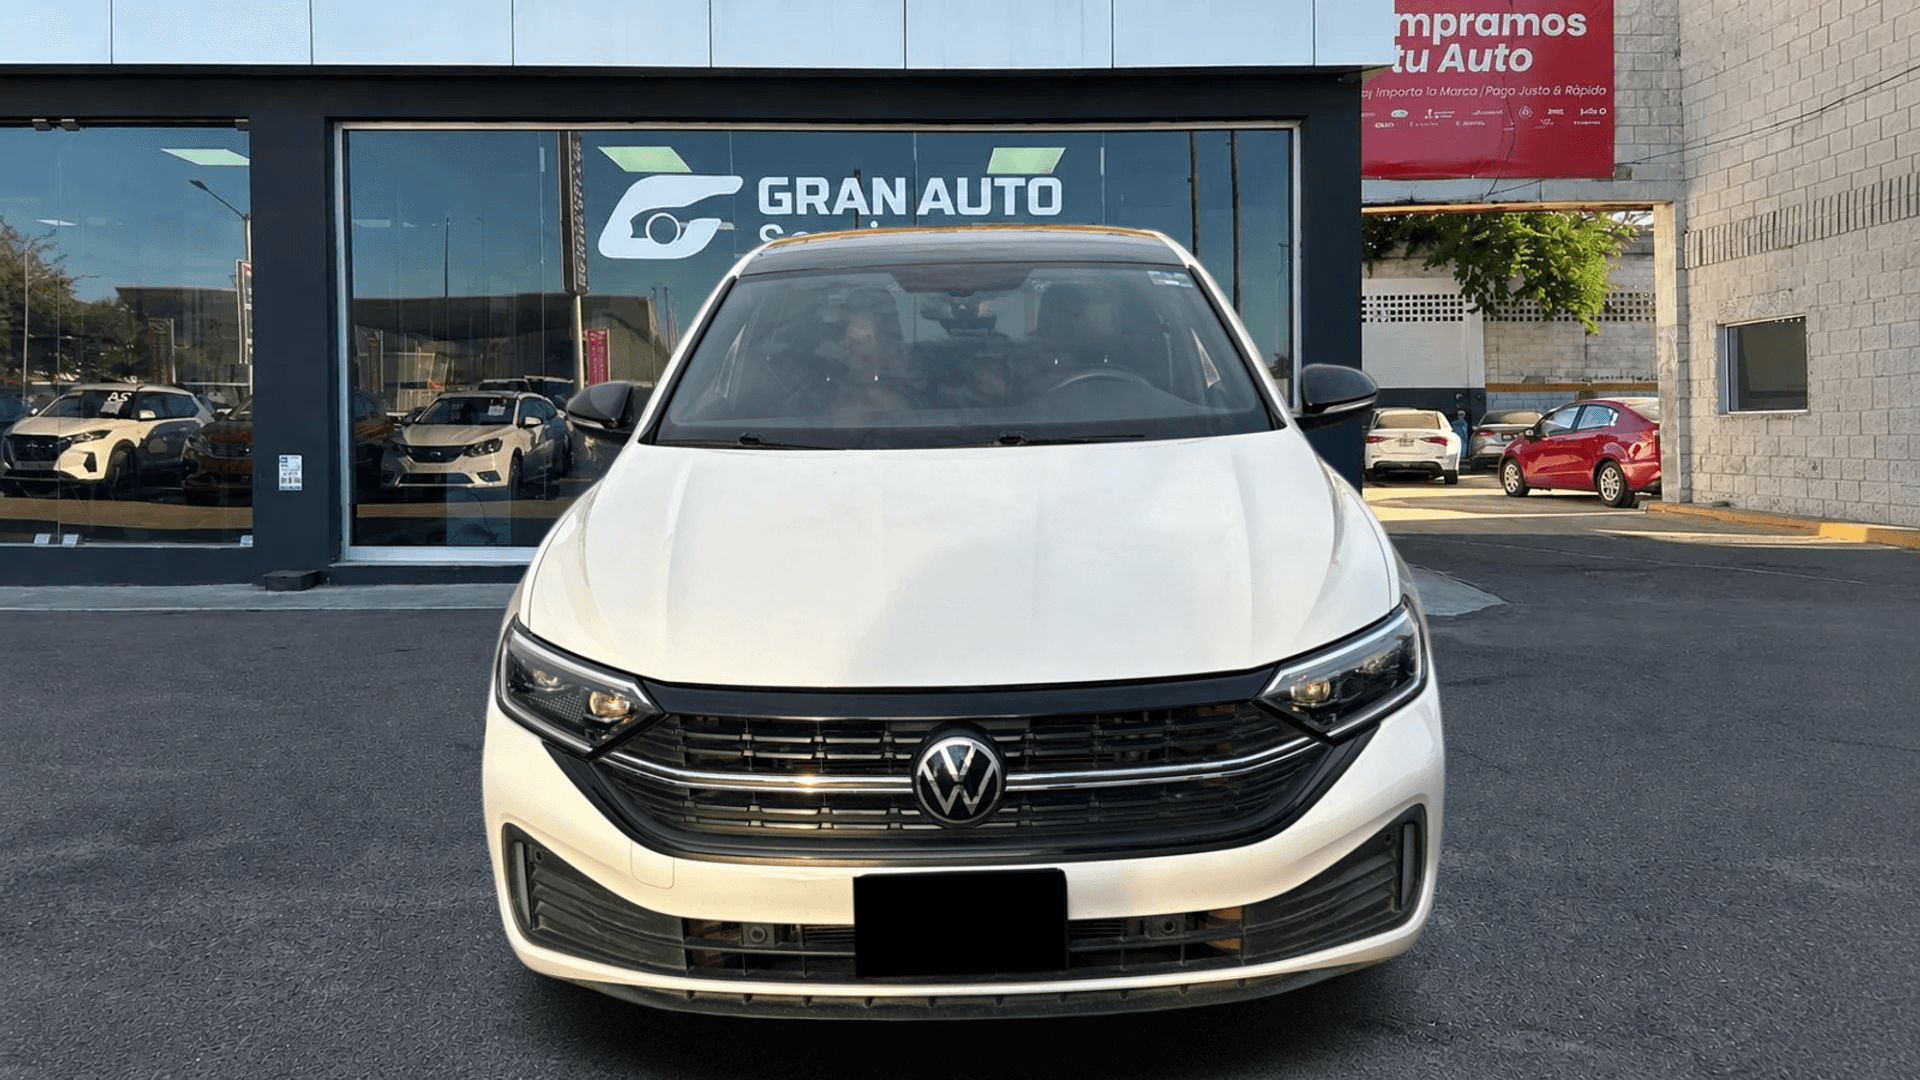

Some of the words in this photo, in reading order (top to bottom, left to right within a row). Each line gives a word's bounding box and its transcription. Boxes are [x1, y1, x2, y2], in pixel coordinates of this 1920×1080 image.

[1395, 13, 1587, 45] mpramos
[1392, 44, 1430, 73] tu
[1437, 43, 1533, 73] Auto
[1376, 87, 1423, 99] Importa
[1426, 86, 1437, 96] la
[1440, 86, 1478, 97] Marca
[1518, 86, 1551, 96] Justo
[1553, 85, 1561, 95] &
[758, 177, 906, 216] GRAN
[916, 177, 1063, 216] AUTO
